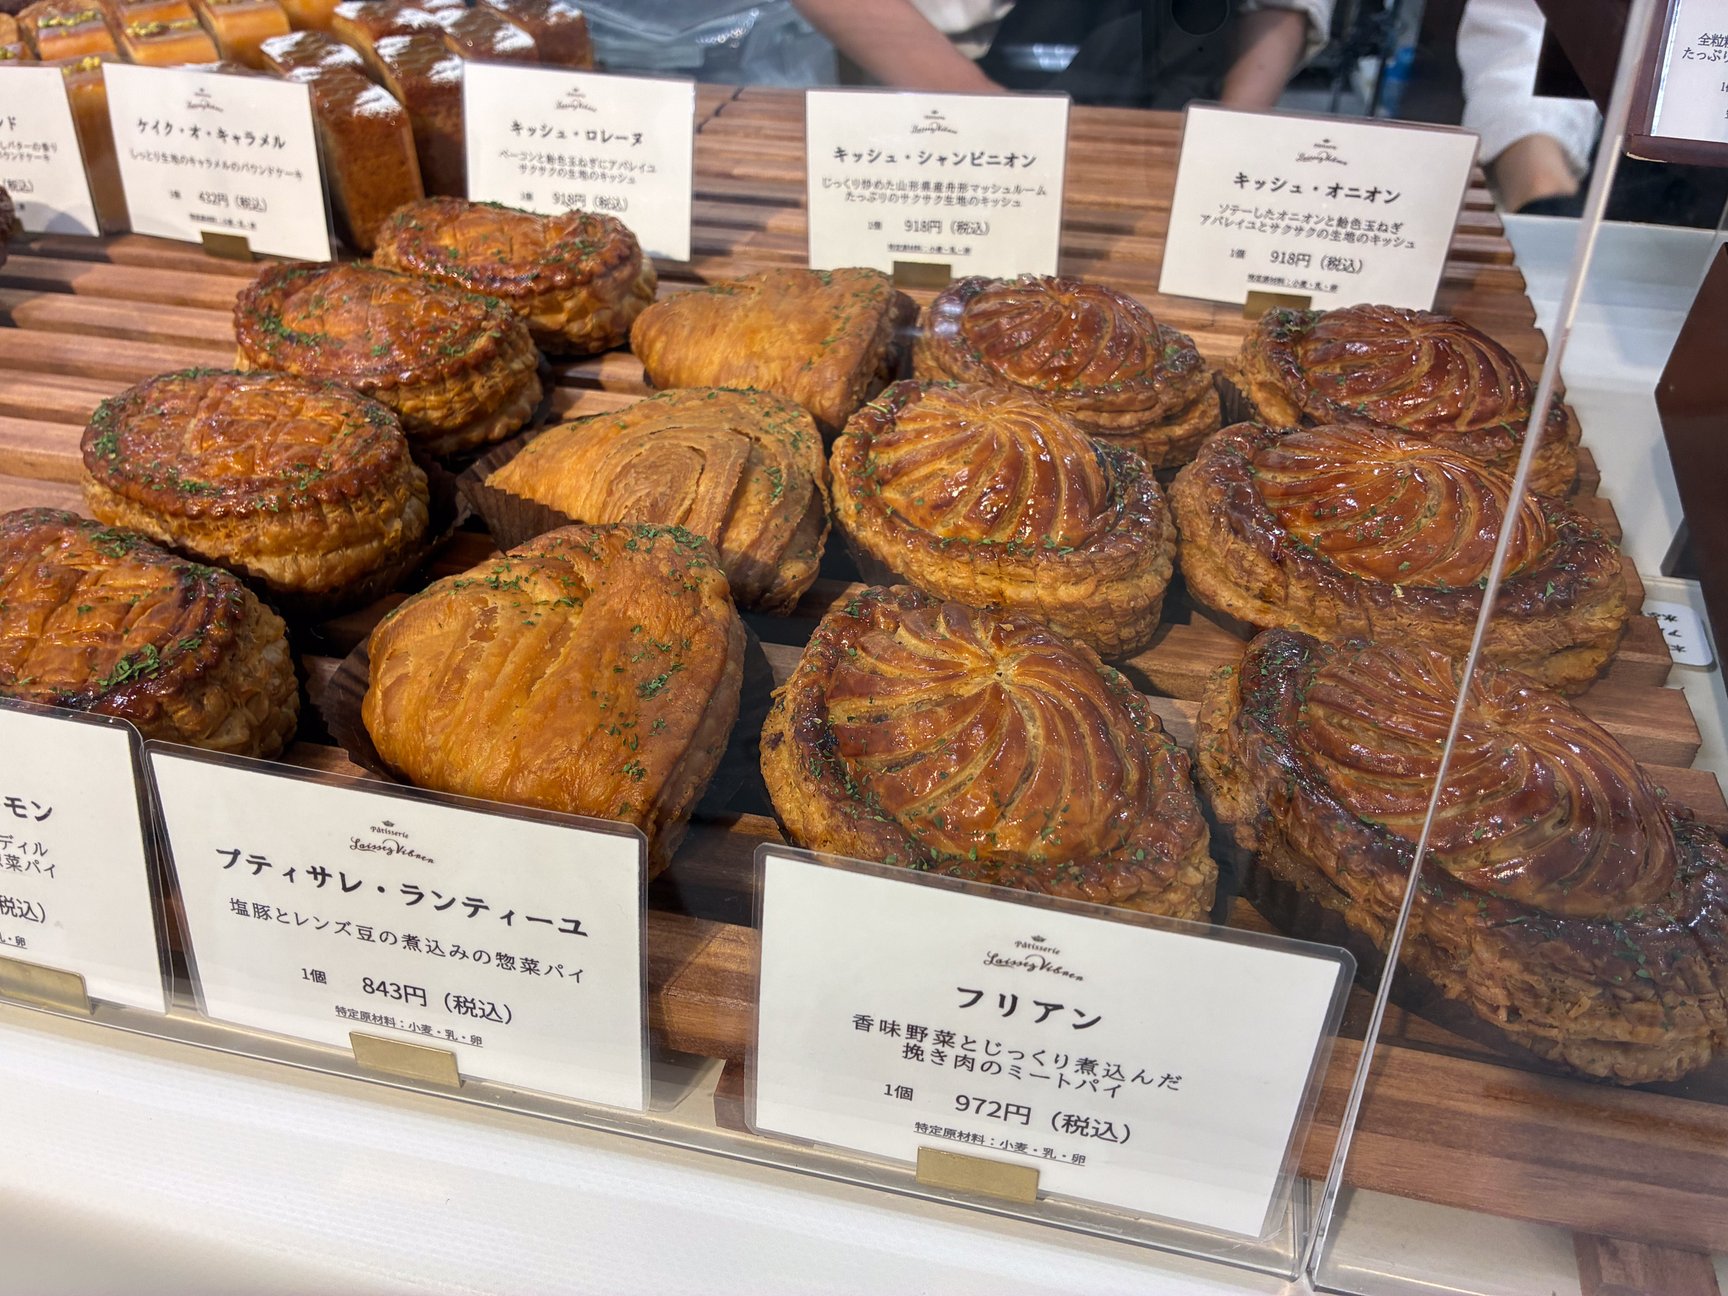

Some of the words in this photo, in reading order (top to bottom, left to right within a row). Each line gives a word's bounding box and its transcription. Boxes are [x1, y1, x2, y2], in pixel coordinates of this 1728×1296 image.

[136, 119, 286, 150] ケイク・オ・キャラメル
[511, 120, 643, 145] キッシュ・ロレーヌ
[833, 146, 1037, 168] キッシュ・シャンピニオン
[845, 193, 1022, 208] たっぷりのサクサク生地のキッシュ
[1234, 171, 1401, 204] キッシュ・オニオン
[1199, 213, 1416, 250] アパレイユとサクサクの生地のキッシュ
[1218, 203, 1404, 235] ソテーしたオニオンと飴色玉ねぎ
[1230, 248, 1246, 260] 1個
[215, 847, 589, 938] プティサレ・ランティーユ
[229, 897, 585, 985] 塩豚とレンズ豆の煮込みの惣菜パイ
[301, 966, 328, 985] 1個
[956, 986, 1104, 1031] フリアン
[334, 1005, 483, 1048] 特定原材料：小麦・乳・卵
[852, 1013, 1184, 1093] 香味野菜とじっくり煮込んだ
[902, 1042, 1123, 1100] 挽き肉のミートパイ
[883, 1082, 914, 1102] 1個
[913, 1120, 1087, 1167] 特定原材料：小麦・乳・卵
